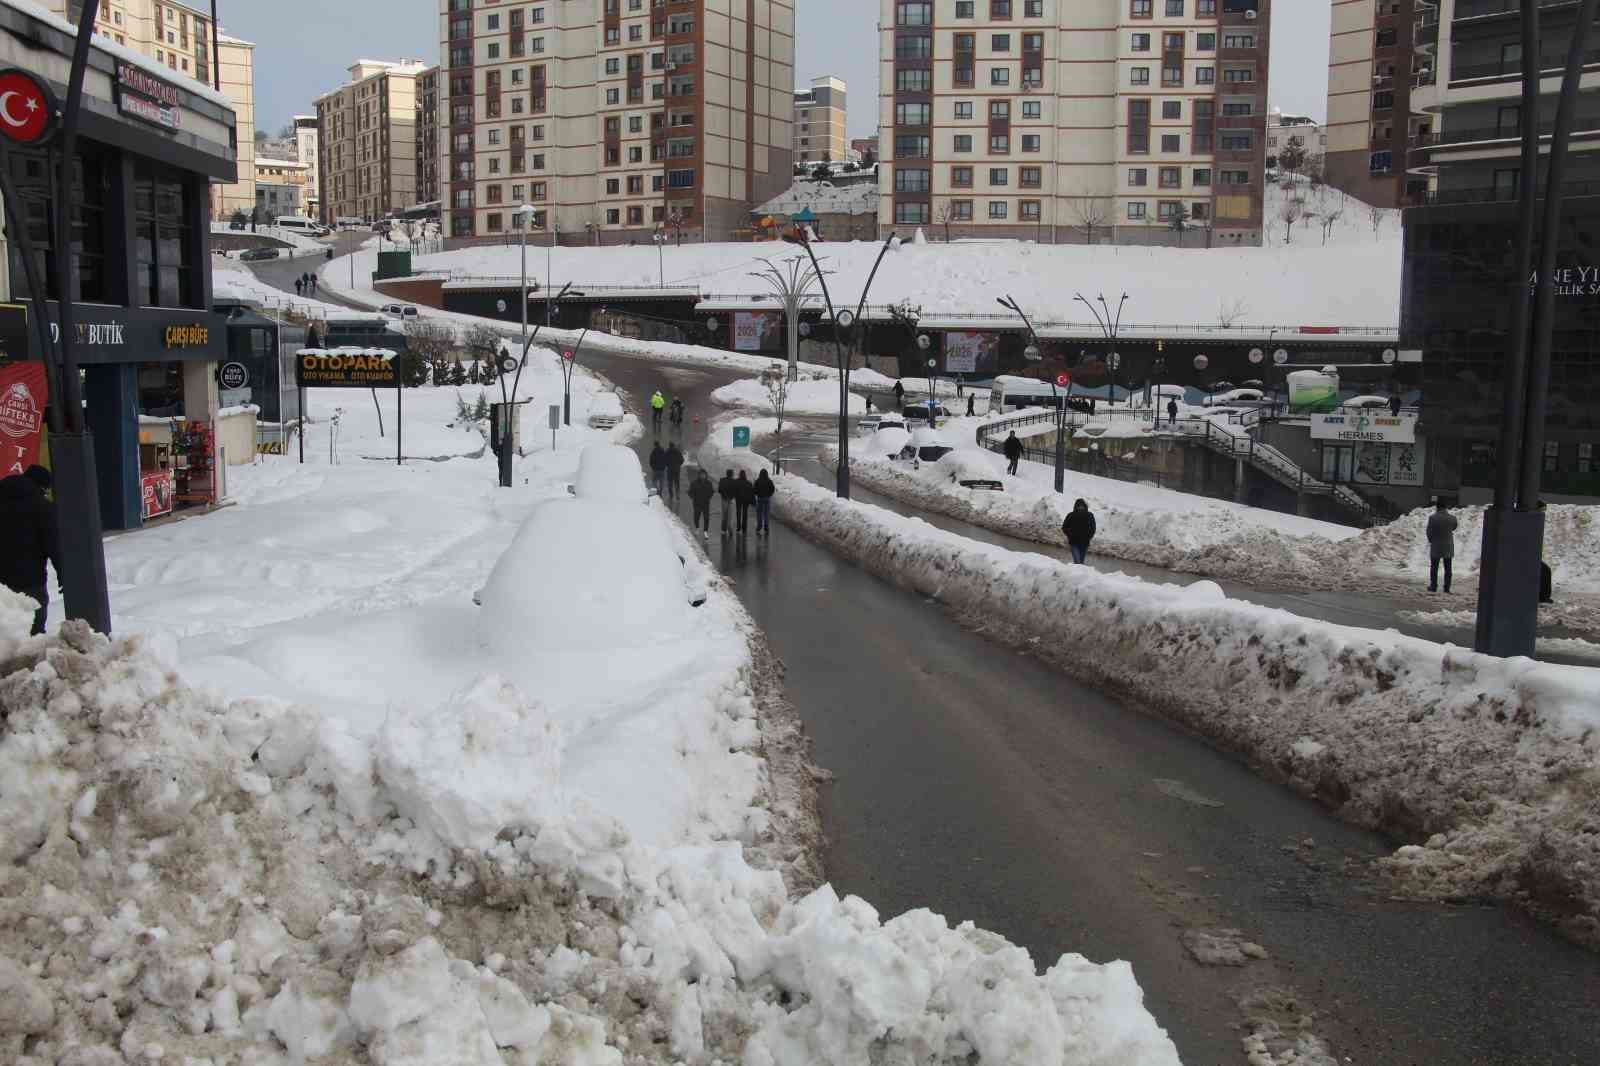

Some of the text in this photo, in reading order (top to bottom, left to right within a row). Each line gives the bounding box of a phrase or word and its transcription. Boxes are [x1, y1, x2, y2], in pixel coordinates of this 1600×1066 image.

[88, 320, 124, 344] BUTİK
[303, 355, 392, 370] OTOPARK
[1338, 431, 1384, 441] HERMES
